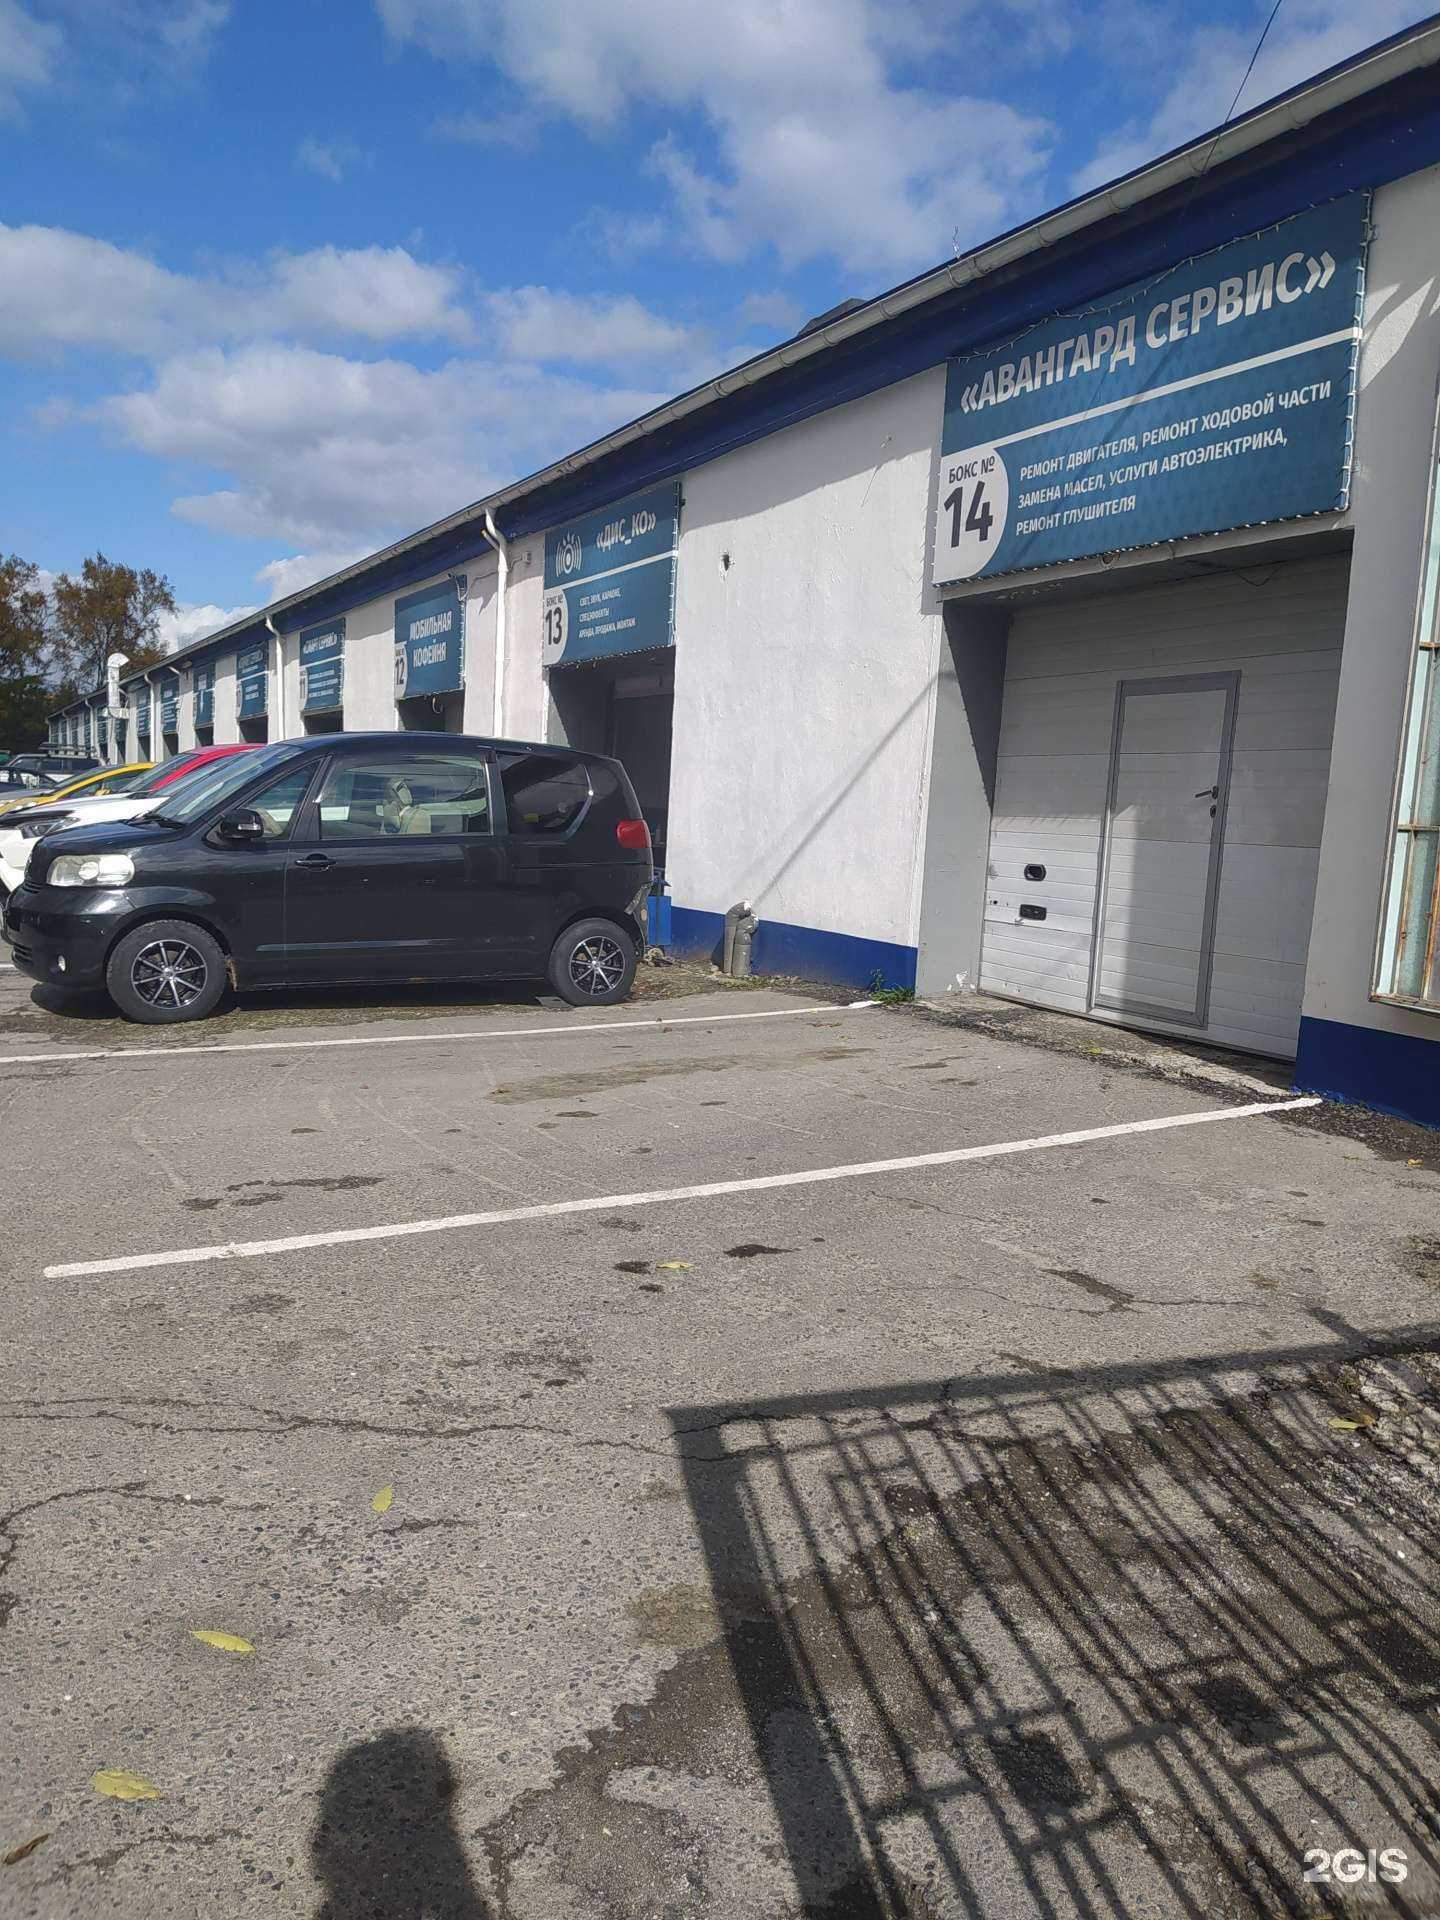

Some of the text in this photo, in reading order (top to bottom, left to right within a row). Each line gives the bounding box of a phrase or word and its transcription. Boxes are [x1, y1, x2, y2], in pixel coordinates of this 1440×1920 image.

[960, 250, 1336, 414] «АВАНГАРД СЕРВИС»
[1020, 380, 1332, 481] РЕМОНТ ДВИГАТЕЛЯ, РЕМОНТ ХОДОВОЙ ЧАСТИ
[948, 455, 996, 484] БОКС №
[1017, 427, 1288, 509] ЗАМЕНА МАСЕЛ, УСЛУГИ АВТОЭЛЕКТРИКА,
[944, 480, 994, 548] 14
[1016, 495, 1137, 536] РЕМОНТ ГЛУШИТЕЛЯ
[410, 611, 453, 641] МОБИЛЬНАЯ
[545, 607, 563, 645] 13
[413, 640, 447, 668] КОФЕЙНЯ
